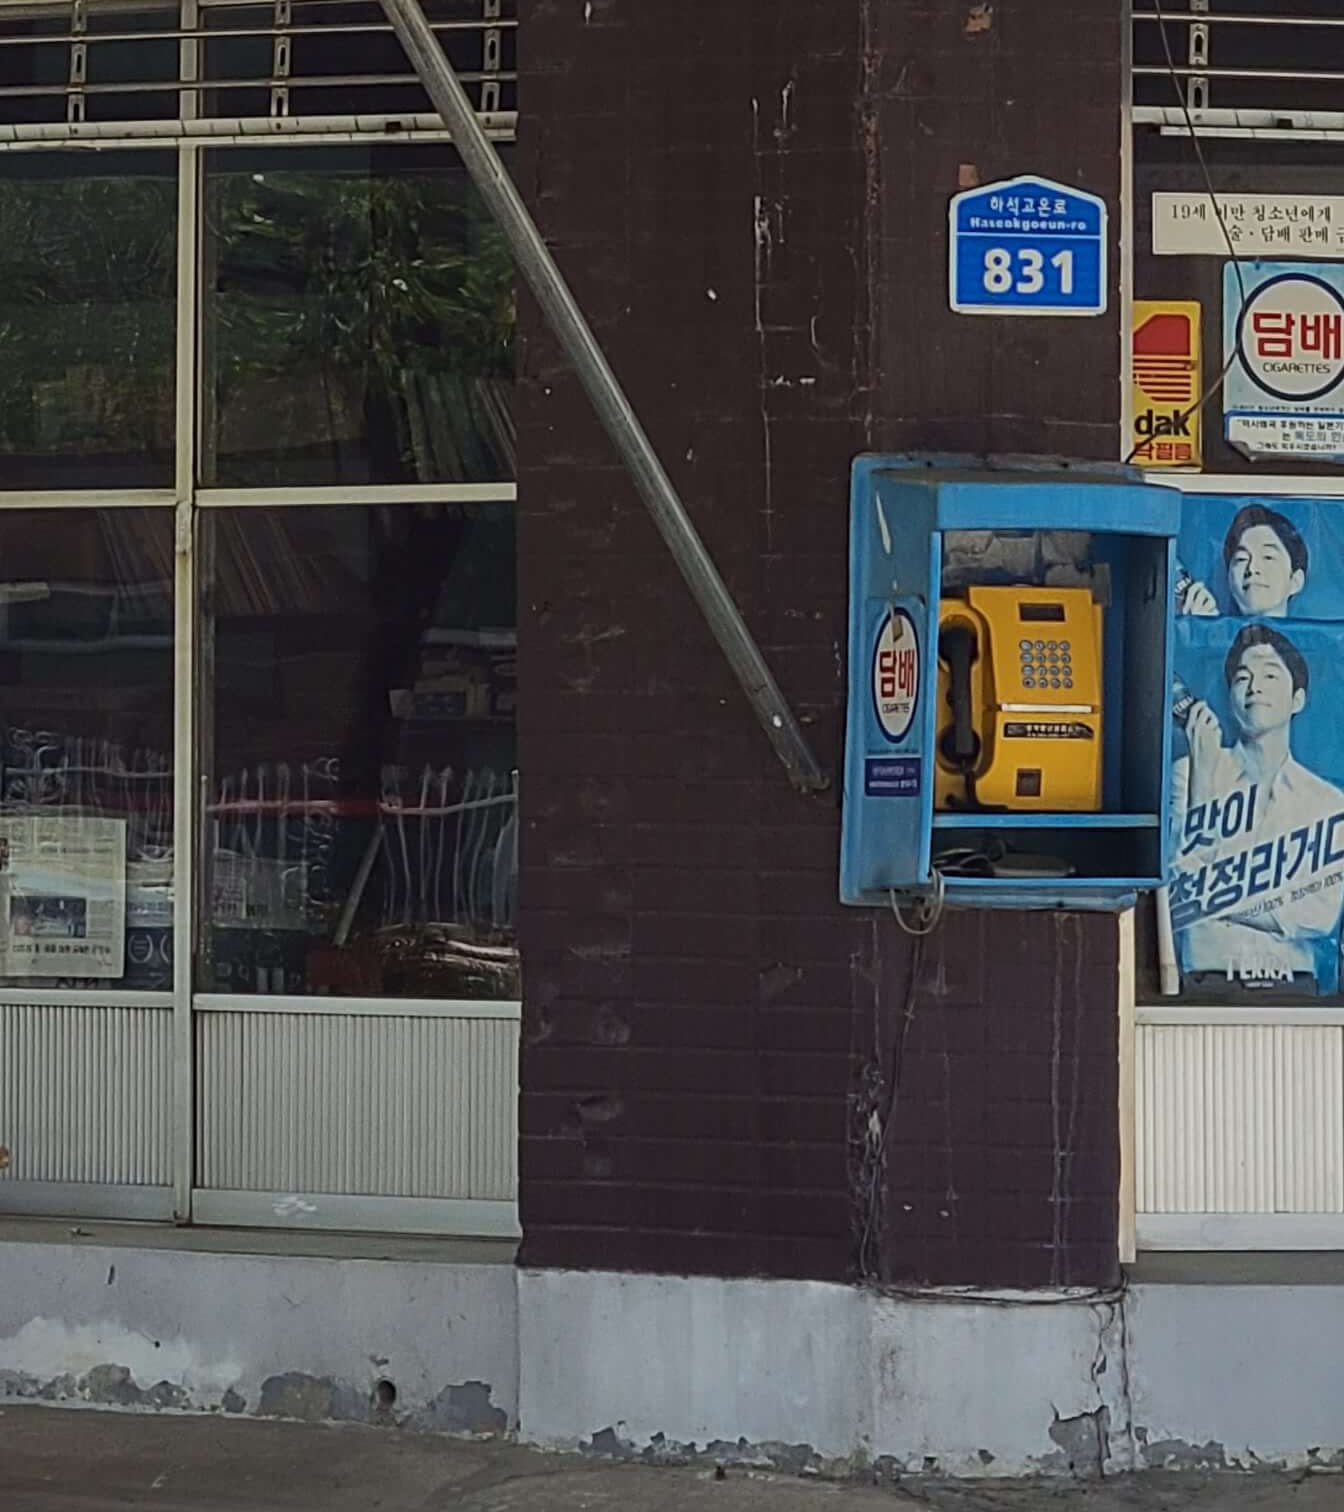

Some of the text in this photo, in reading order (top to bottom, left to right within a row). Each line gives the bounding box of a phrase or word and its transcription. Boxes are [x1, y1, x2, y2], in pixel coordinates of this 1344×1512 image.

[970, 217, 1087, 231] Haseokgoeun-ro
[1170, 204, 1207, 221] 19세
[1253, 204, 1332, 222] 청소년에게
[1298, 227, 1329, 244] 판매
[983, 248, 1074, 294] 831
[1252, 312, 1343, 360] 담배
[1262, 362, 1331, 374] CIGARETTES
[1134, 408, 1191, 437] dak
[879, 648, 916, 698] 담배
[1182, 784, 1258, 856] 맛이
[1222, 955, 1296, 983] TERRA
